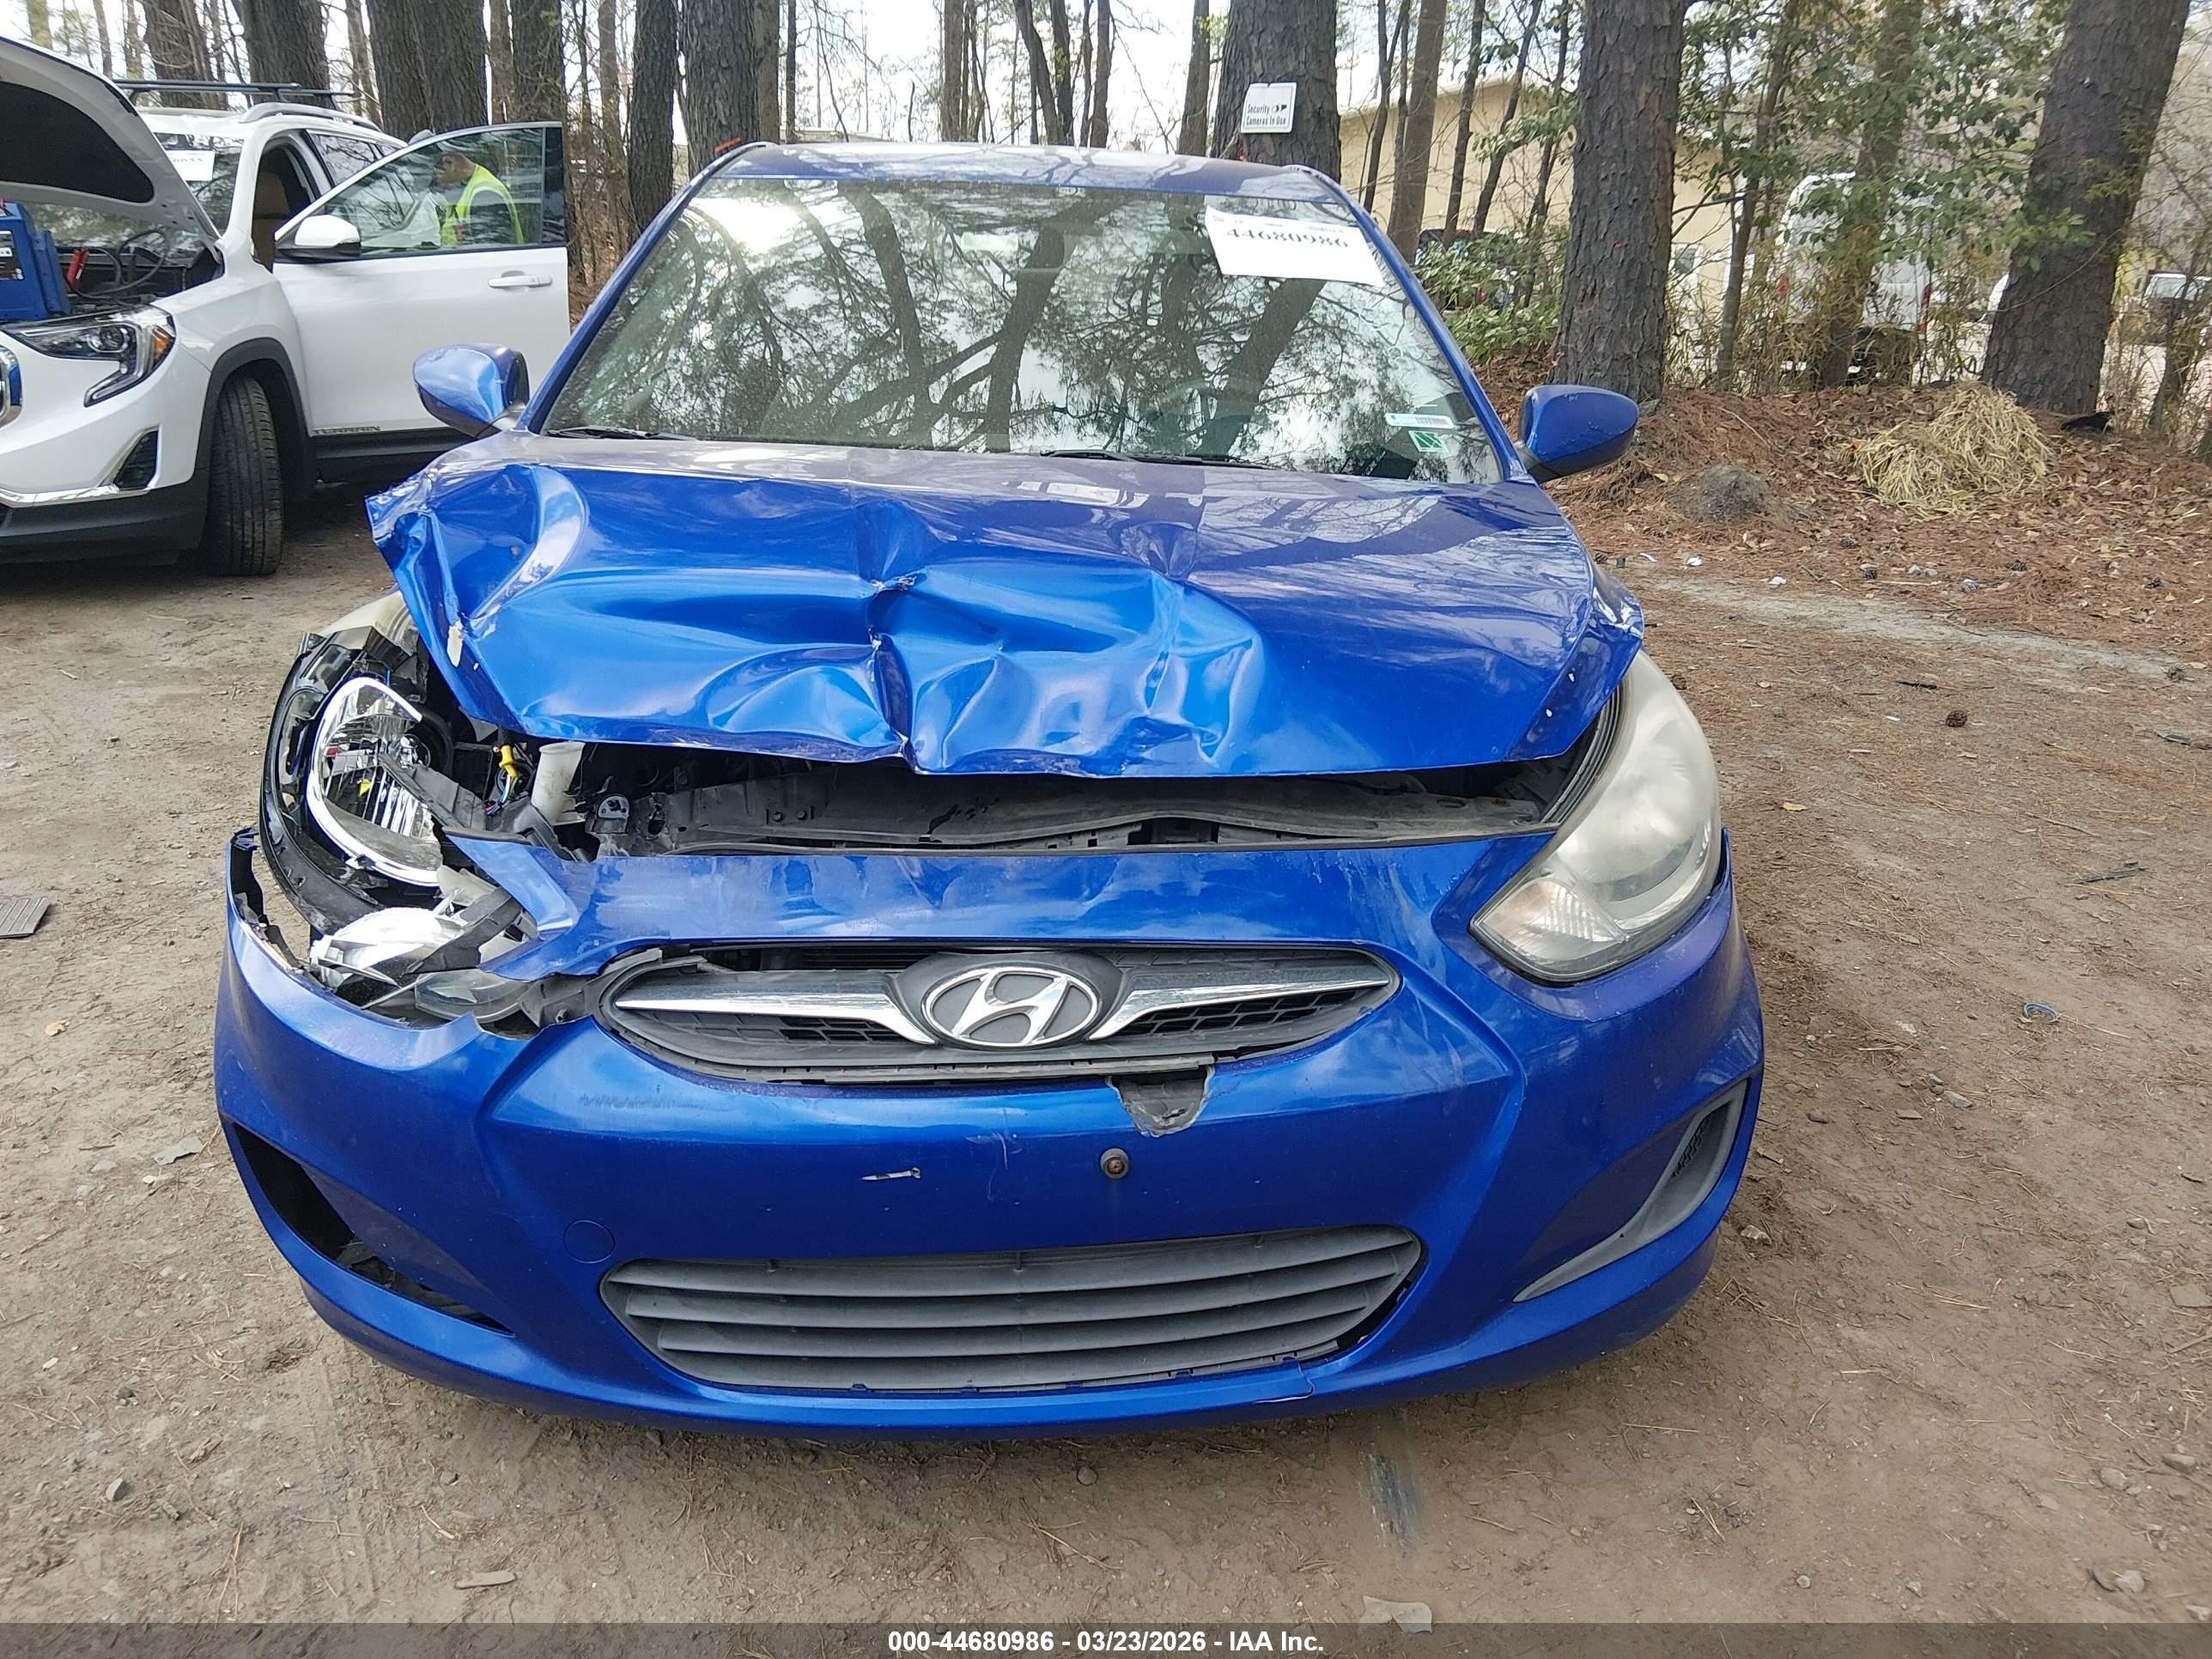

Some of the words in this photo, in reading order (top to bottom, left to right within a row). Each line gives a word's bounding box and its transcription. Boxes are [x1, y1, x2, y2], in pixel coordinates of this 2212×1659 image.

[1248, 103, 1270, 115] Security
[1246, 116, 1267, 125] Cameras
[1276, 116, 1286, 125] Use
[1226, 228, 1349, 248] 44680986
[312, 426, 380, 434] TERRAIN
